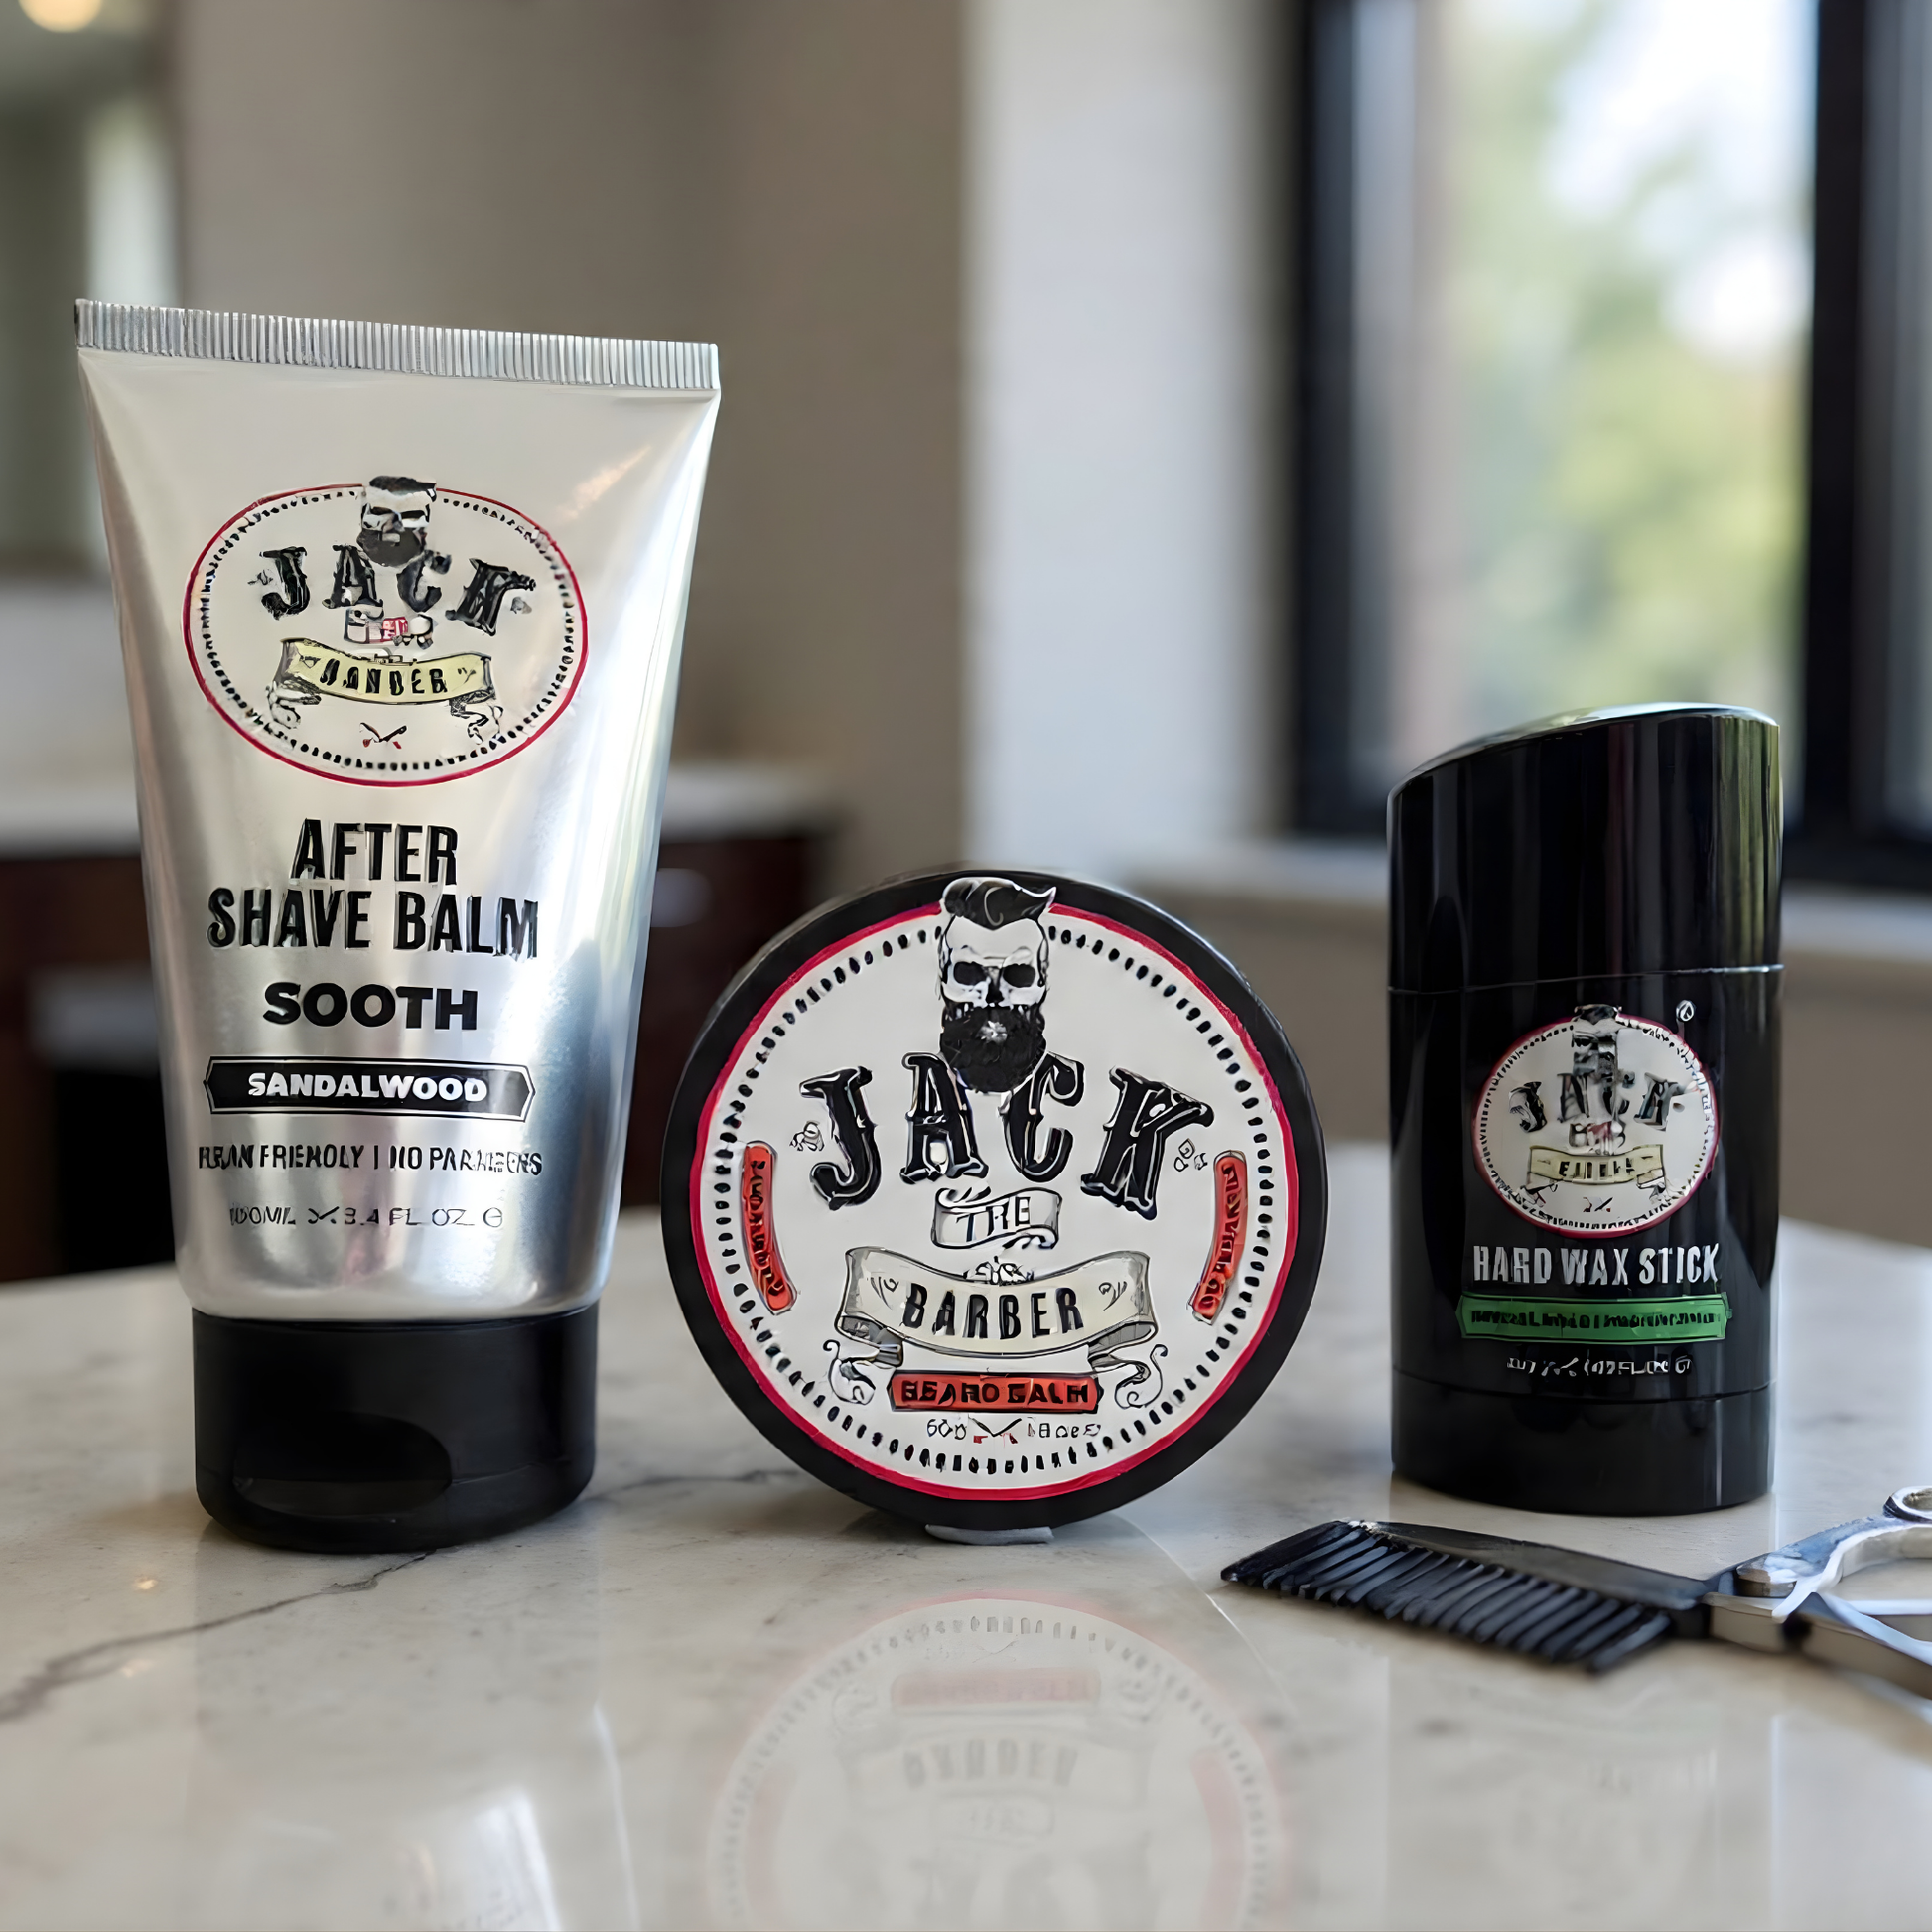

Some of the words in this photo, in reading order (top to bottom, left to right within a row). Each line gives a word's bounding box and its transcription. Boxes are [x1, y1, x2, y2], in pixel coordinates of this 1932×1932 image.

[290, 817, 459, 885] AFTER
[207, 887, 373, 949] SHAVE
[394, 890, 539, 961] BALM
[262, 981, 479, 1031] SOOTH
[247, 1071, 488, 1103] SANDALWOOD
[799, 1052, 1214, 1219] JACK
[1472, 1245, 1552, 1284] HARD
[1560, 1247, 1628, 1285] WAX
[1638, 1242, 1720, 1285] STICK
[899, 1283, 1084, 1339] BARBER
